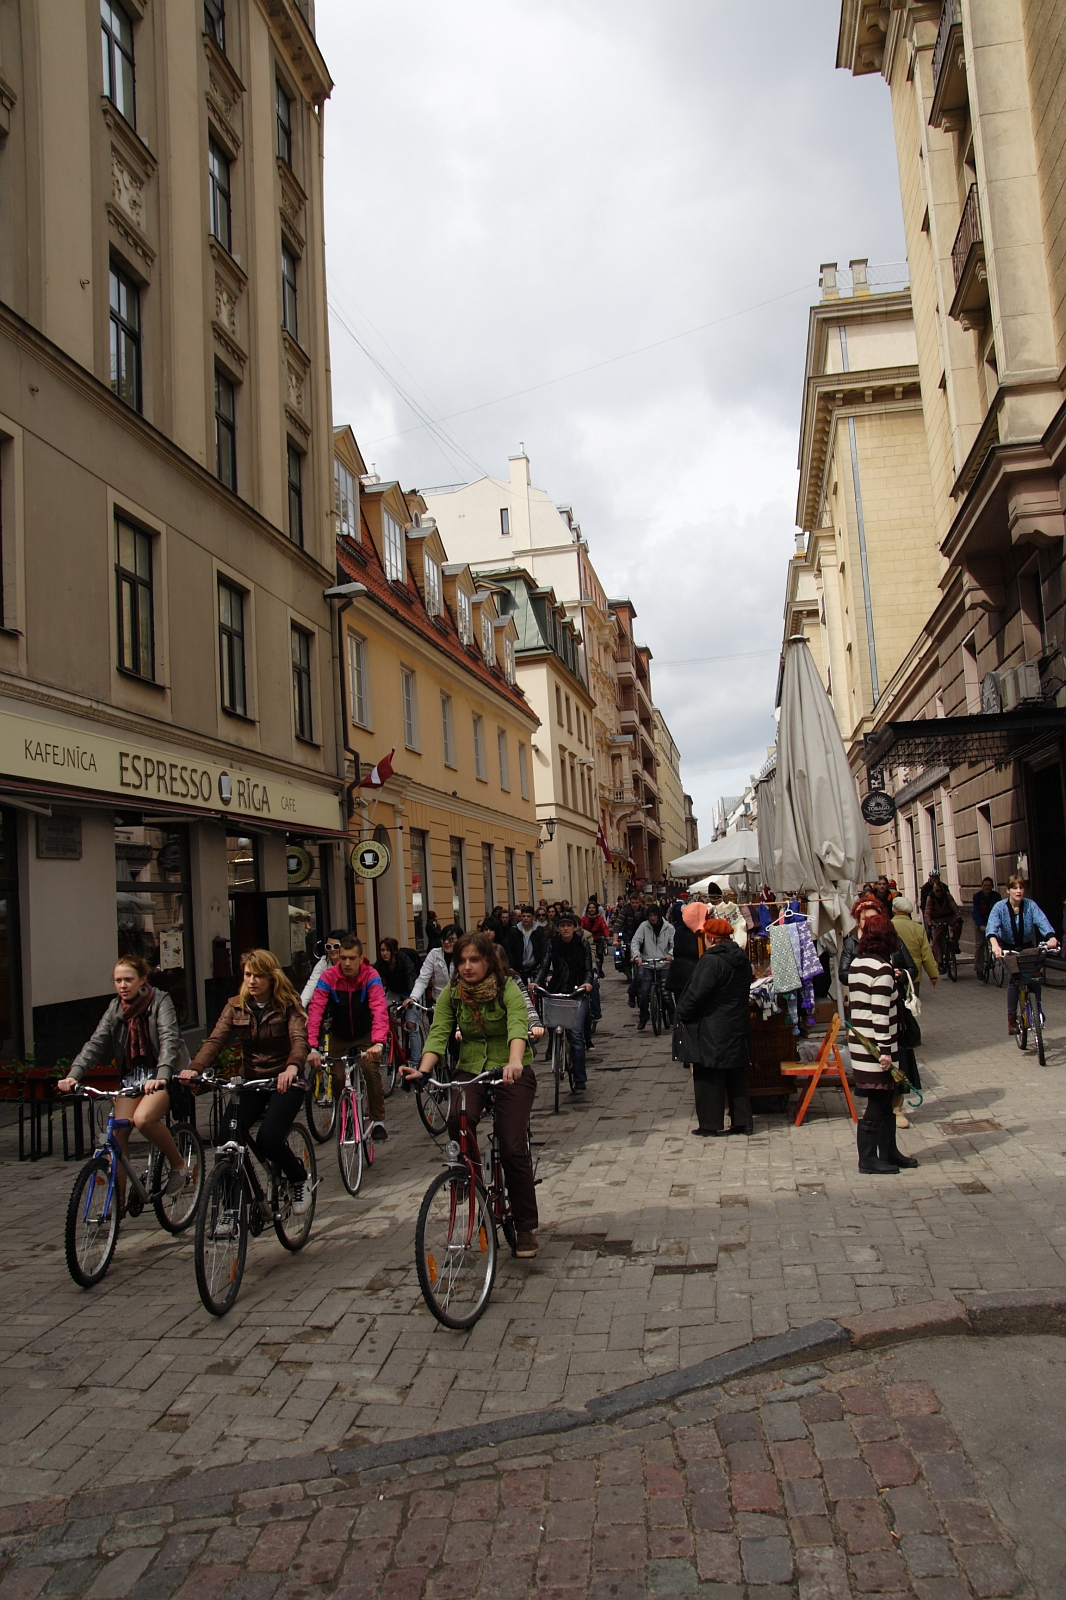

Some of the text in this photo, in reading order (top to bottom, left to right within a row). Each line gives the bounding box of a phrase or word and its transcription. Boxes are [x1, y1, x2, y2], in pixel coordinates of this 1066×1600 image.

[24, 739, 98, 773] KAFEJNĪCA
[119, 751, 271, 813] ESPRESSO RĪGA
[280, 796, 297, 812] CAFE
[353, 842, 376, 861] ESPRESSO
